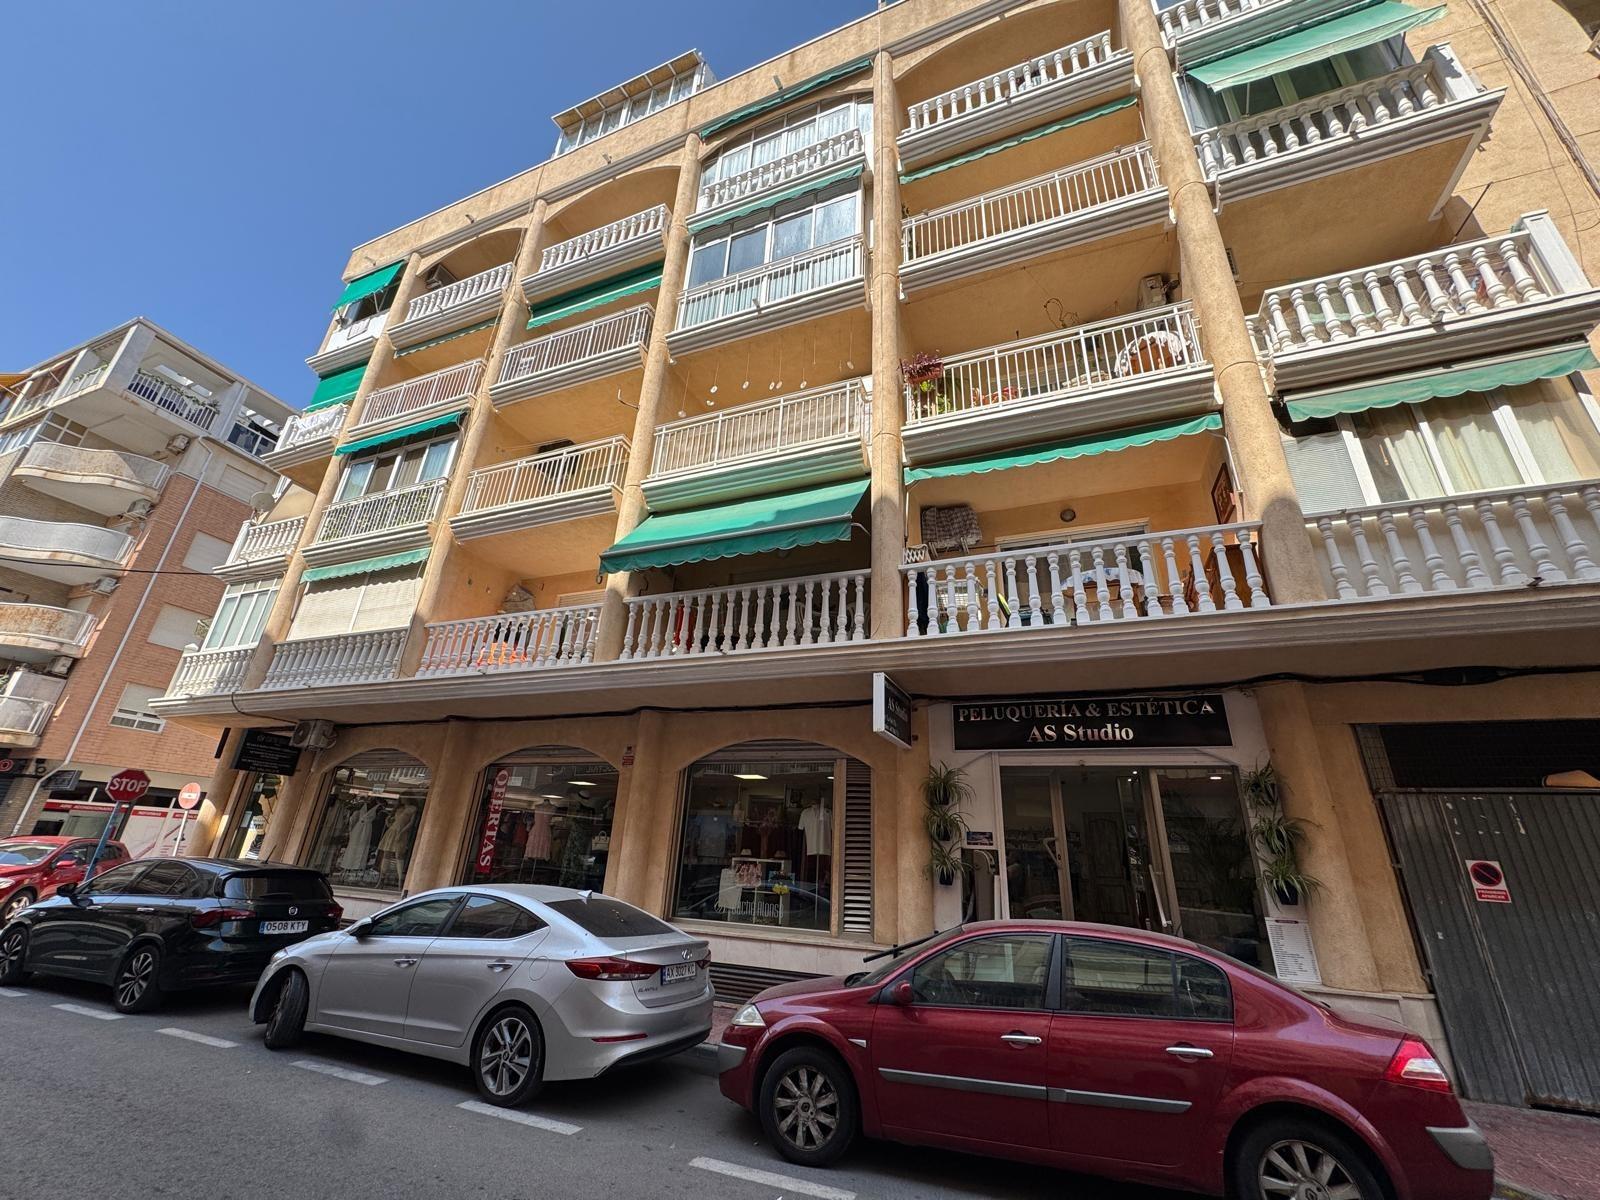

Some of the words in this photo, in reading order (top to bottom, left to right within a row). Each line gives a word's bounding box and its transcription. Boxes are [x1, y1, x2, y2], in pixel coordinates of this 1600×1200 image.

[958, 700, 1081, 722] PELUQUERÍA
[1085, 703, 1101, 717] &
[1107, 698, 1215, 717] ESTÉTICA
[1027, 724, 1057, 743] AS
[1063, 723, 1134, 742] Studio
[110, 777, 148, 792] STOP
[480, 769, 509, 866] OFERTAS
[266, 922, 289, 932] 0508
[290, 921, 306, 931] KTY
